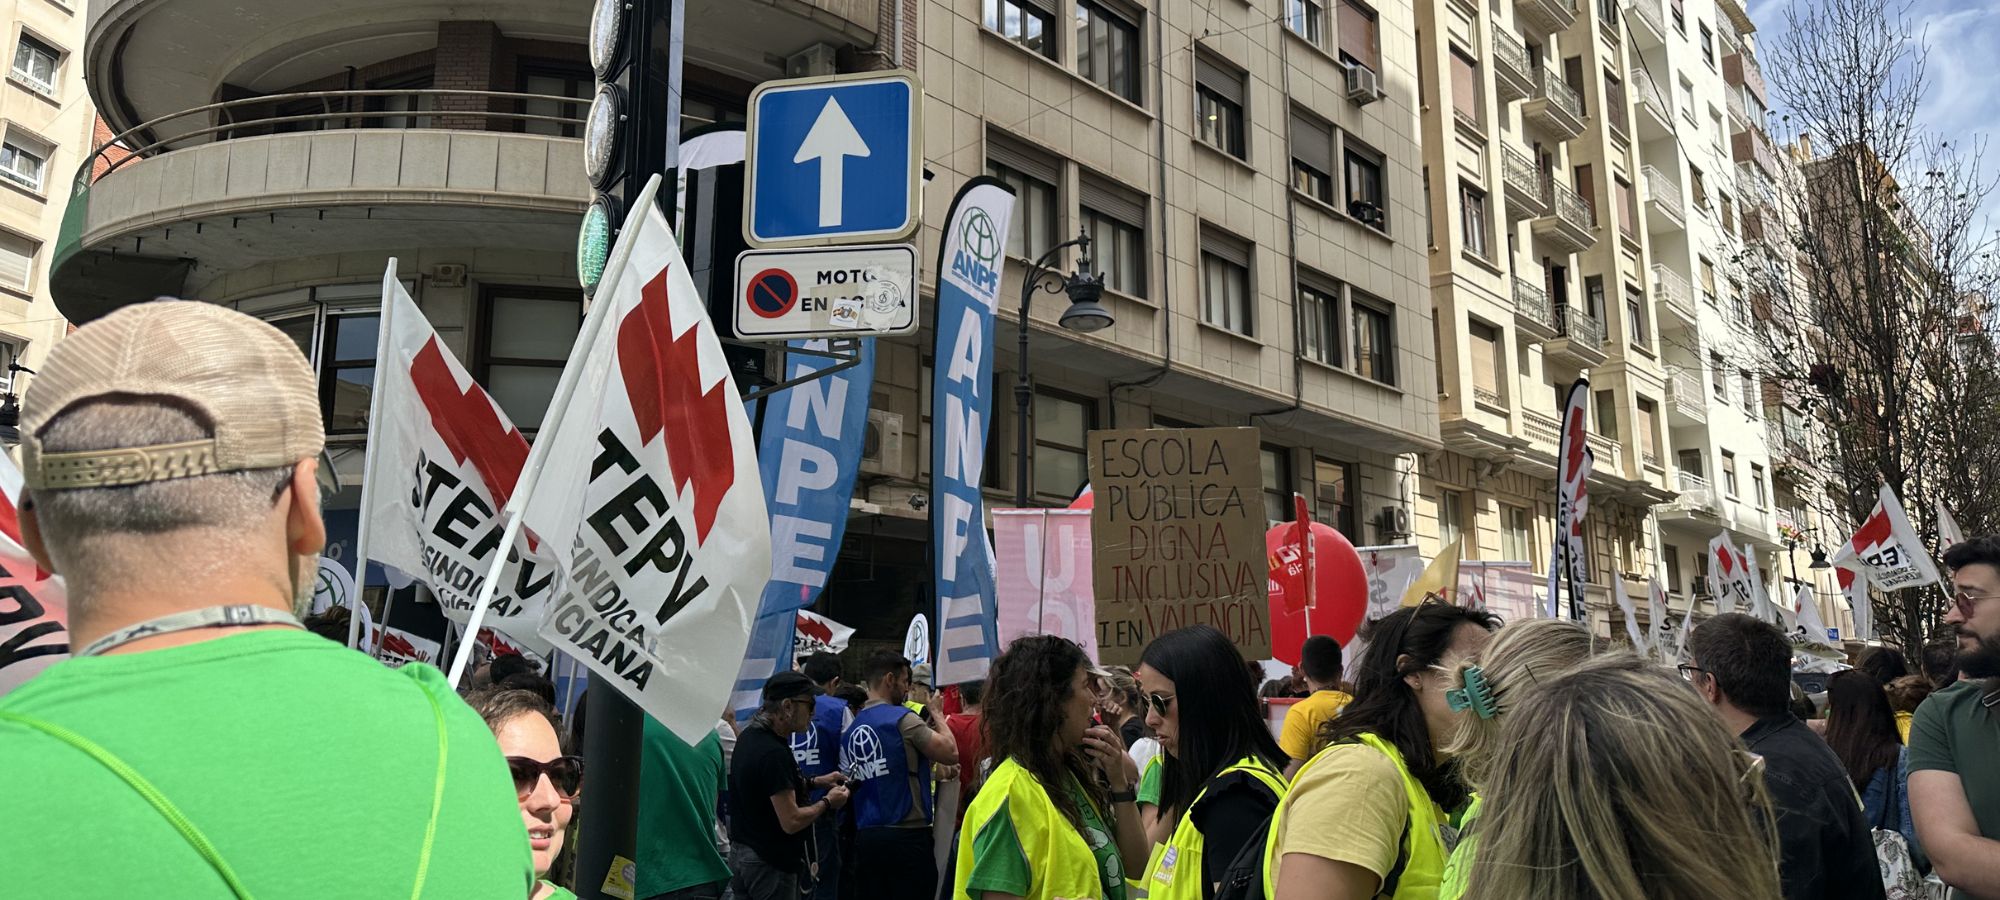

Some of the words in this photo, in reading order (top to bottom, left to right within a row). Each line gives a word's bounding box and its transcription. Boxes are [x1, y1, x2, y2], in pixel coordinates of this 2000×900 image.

[801, 298, 828, 312] EN
[1101, 437, 1229, 479] ESCOLA
[1108, 479, 1246, 522] PÚBLICA
[1129, 522, 1231, 561] DIGNA
[1111, 558, 1261, 603] INCLUSIVA
[1116, 619, 1143, 648] EN
